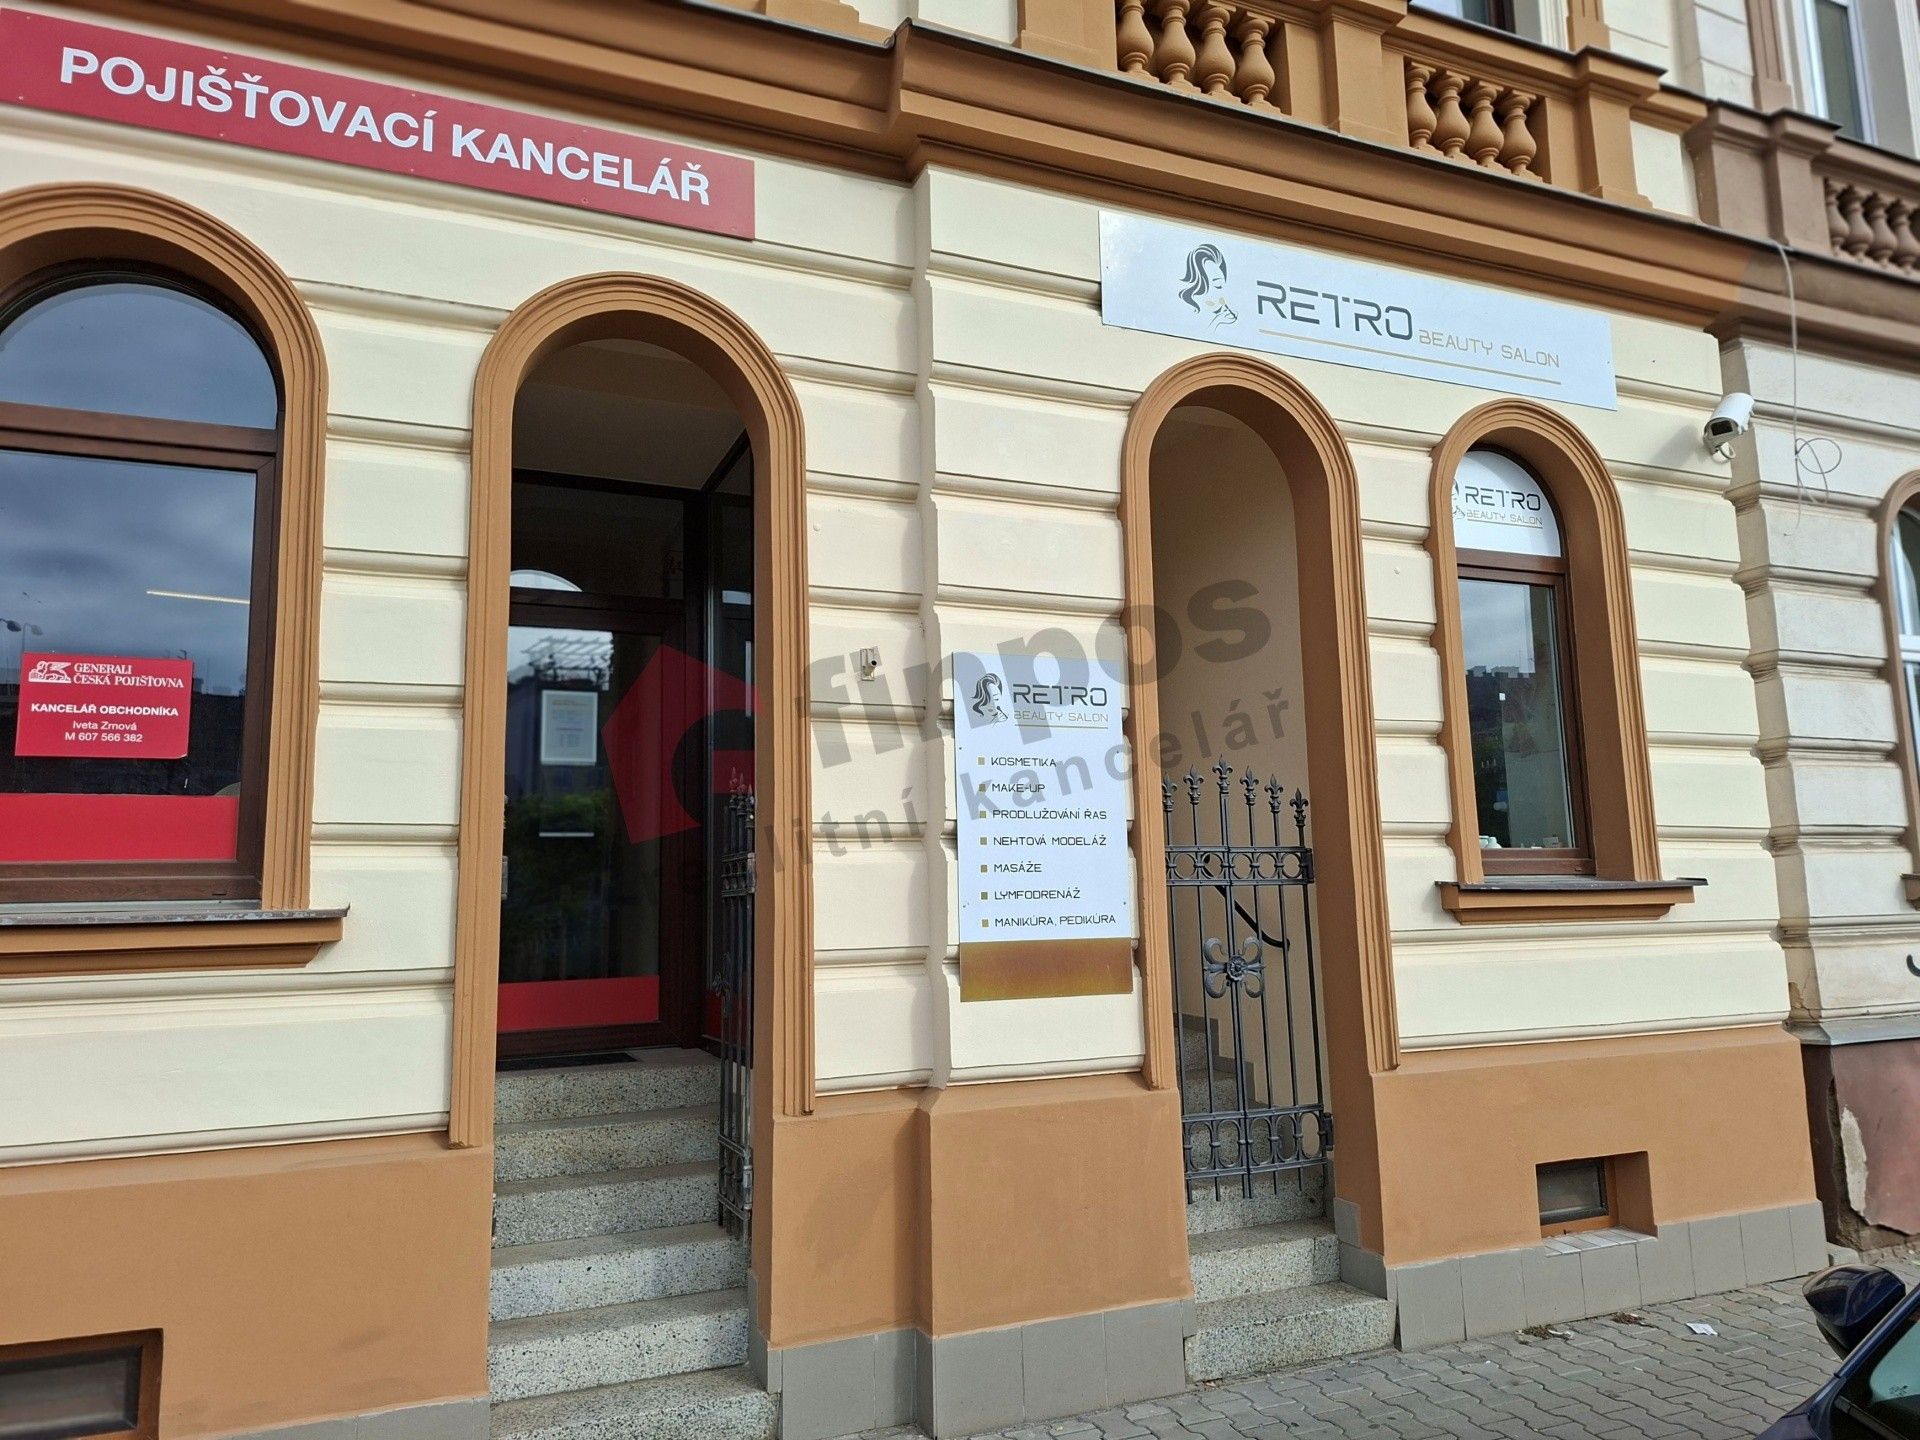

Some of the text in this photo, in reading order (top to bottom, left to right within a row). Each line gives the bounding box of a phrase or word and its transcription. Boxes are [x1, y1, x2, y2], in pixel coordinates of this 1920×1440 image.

[60, 46, 710, 206] POJIŠŤOVACÍ KANCELÁŘ
[1256, 280, 1414, 342] RETRO
[1419, 329, 1561, 369] BEAUTY SALON
[1464, 486, 1542, 512] RETRO
[1466, 509, 1543, 526] BEAUTY SALON
[74, 663, 132, 675] GENERALI
[74, 672, 185, 689] ČESKÁ POJIŠŤOVNA
[1012, 683, 1108, 707] RETRO
[31, 702, 179, 717] KANCELÁŘ OBCHODNÍKA
[1014, 710, 1109, 723] BEAUTY SALON
[72, 721, 98, 731] Iveta
[65, 732, 143, 743] M 607 566 382
[991, 757, 1057, 768] KOSMETIKA
[992, 783, 1045, 793] MAKE-UP
[992, 807, 1107, 820] PRODLUŽOVÁNÍ ŘAS
[993, 834, 1107, 846] NEHTOVÁ MODELÁŽ
[994, 861, 1042, 873] MASÁŽE
[994, 887, 1081, 900] LYMFODRENÁŽ
[995, 913, 1116, 928] MANIKÚRA, PEDIKÚRA
